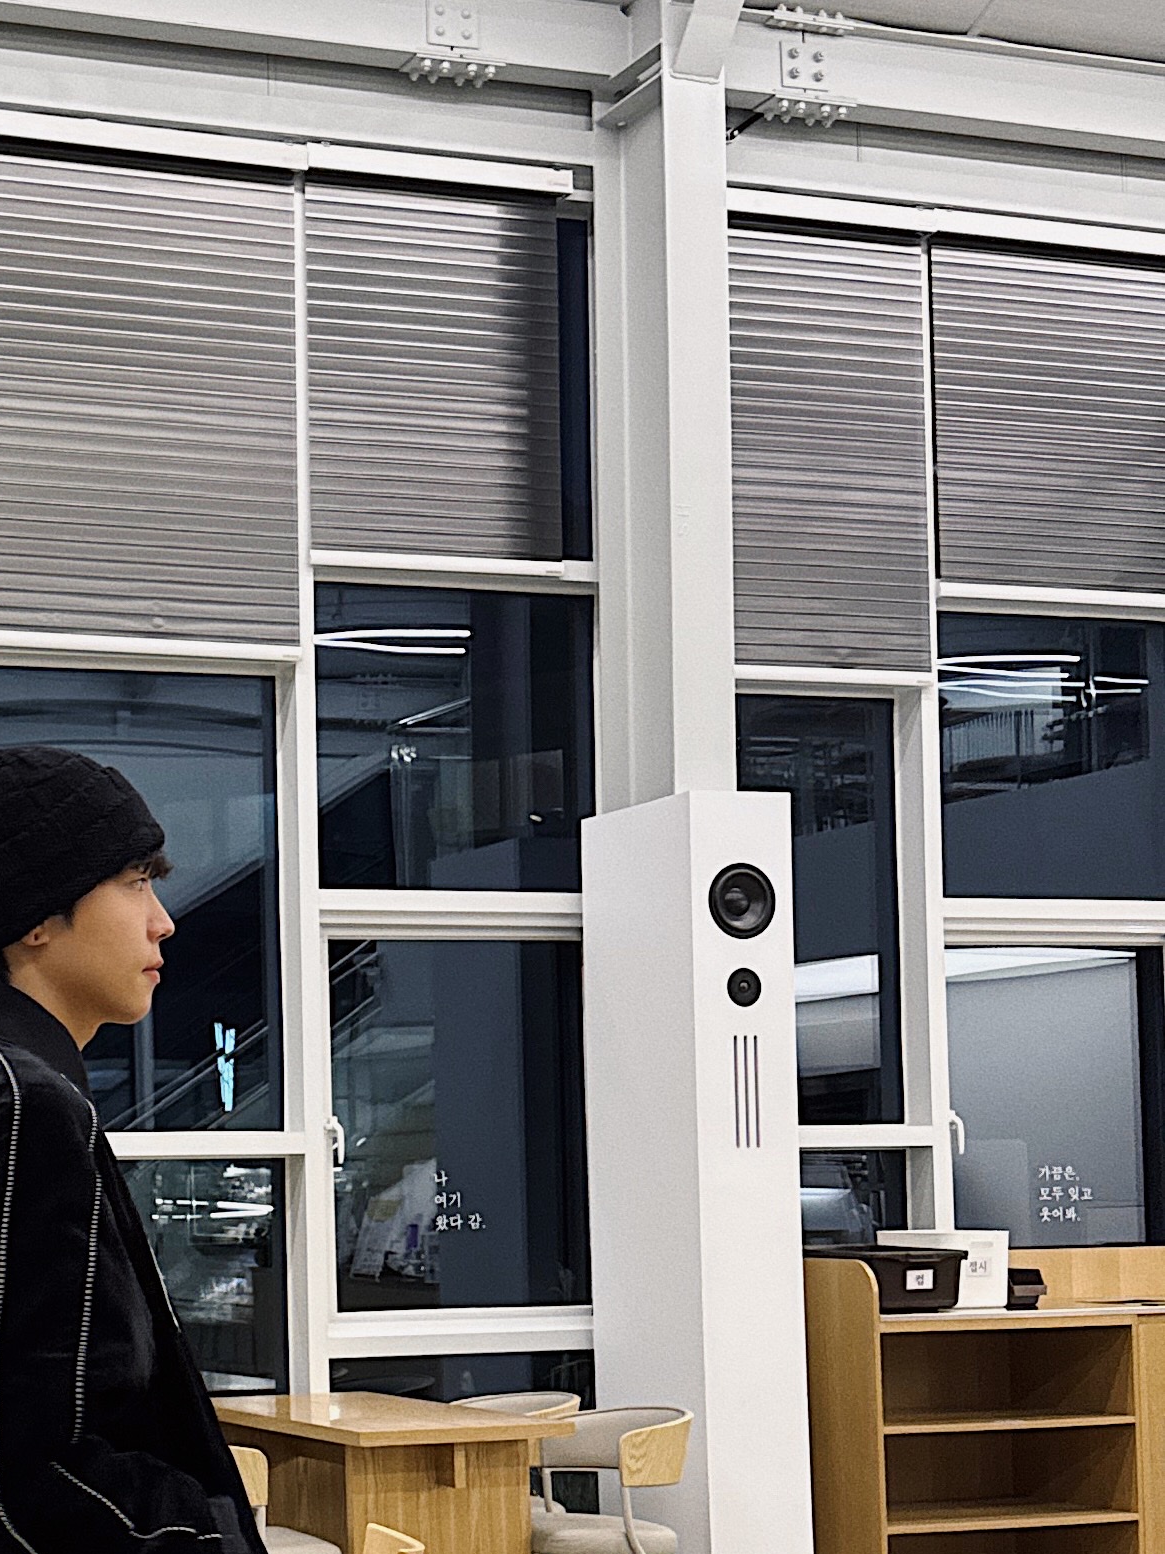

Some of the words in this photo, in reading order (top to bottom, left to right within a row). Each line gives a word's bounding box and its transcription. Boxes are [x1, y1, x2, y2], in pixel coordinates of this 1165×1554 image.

[433, 1170, 448, 1187] 나
[434, 1191, 461, 1208] 여기
[1039, 1186, 1064, 1202] 모두
[1068, 1186, 1094, 1201] 잊고
[435, 1213, 463, 1231] 왔다
[468, 1212, 486, 1230] 감.
[1039, 1206, 1081, 1223] 웃어봐.
